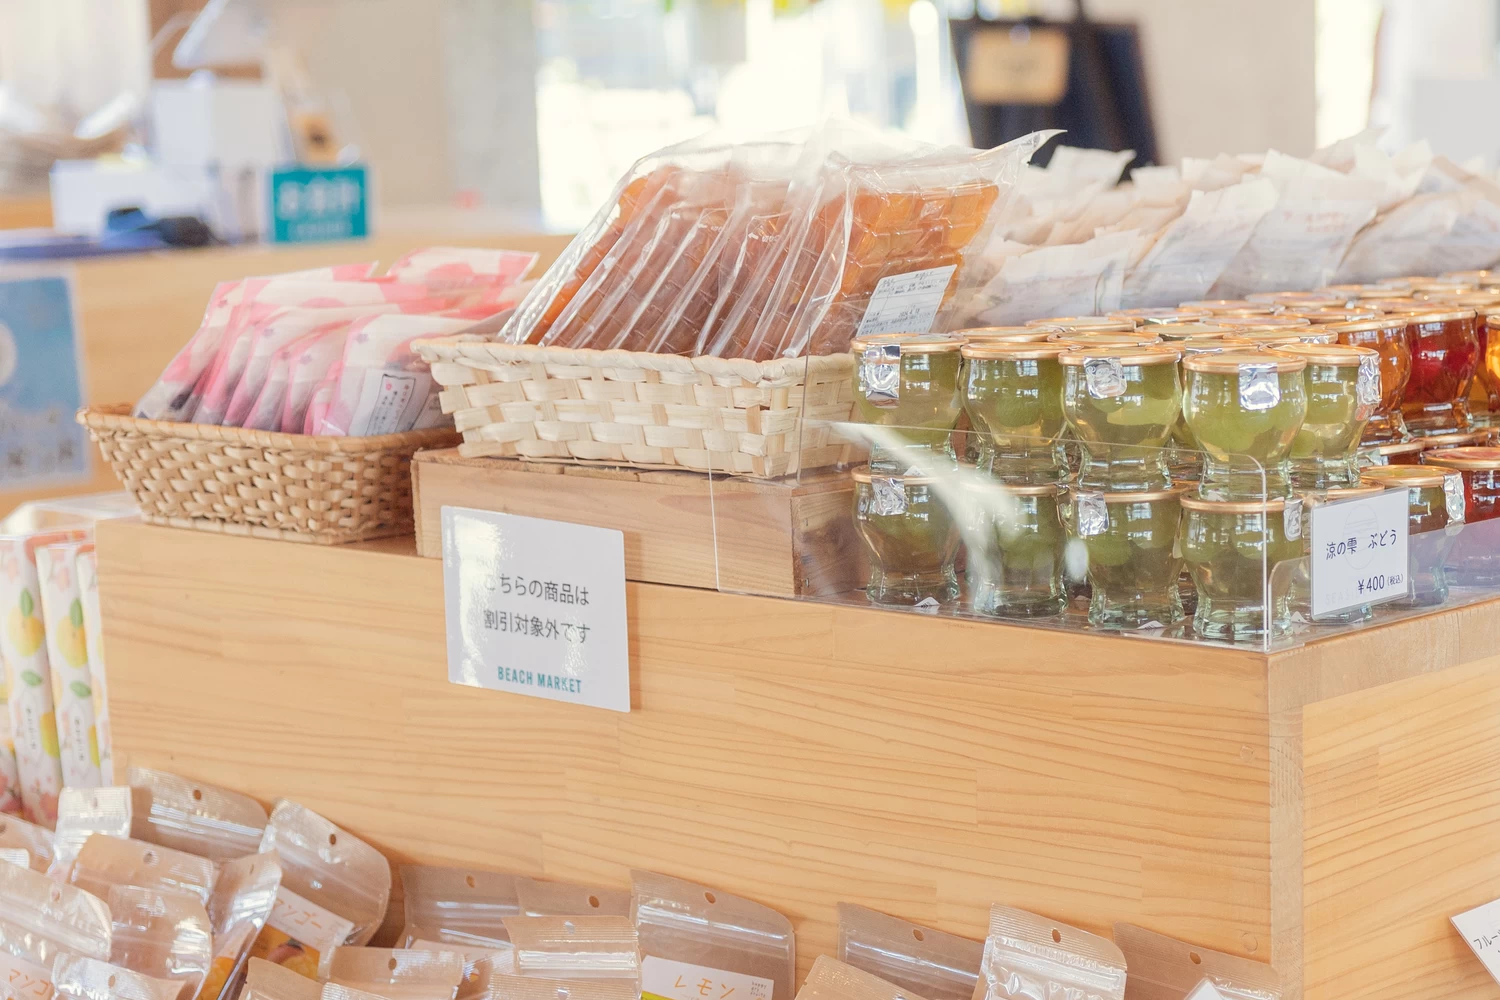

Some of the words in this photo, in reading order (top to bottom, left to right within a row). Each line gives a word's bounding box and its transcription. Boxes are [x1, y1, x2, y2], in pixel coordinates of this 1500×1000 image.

[1326, 537, 1357, 560] 涼の雫
[1368, 529, 1397, 549] ぶどう
[1358, 575, 1385, 594] ¥400
[483, 609, 591, 643] 割引対象外です
[498, 666, 533, 685] BEACH
[537, 673, 582, 694] MARKET
[674, 974, 735, 1000] レモン
